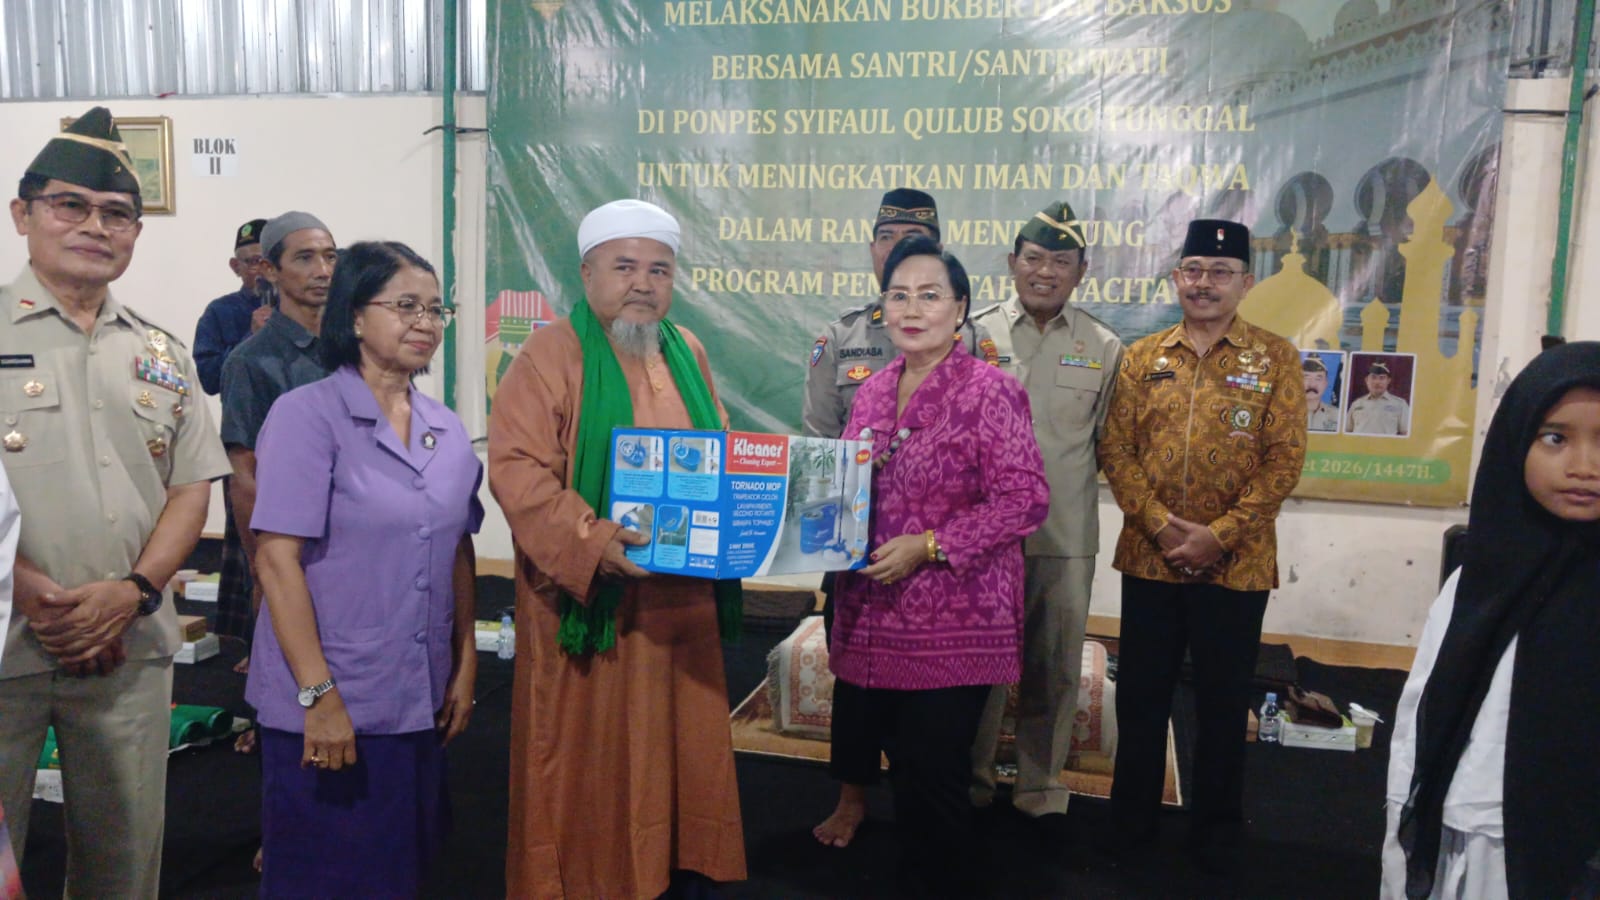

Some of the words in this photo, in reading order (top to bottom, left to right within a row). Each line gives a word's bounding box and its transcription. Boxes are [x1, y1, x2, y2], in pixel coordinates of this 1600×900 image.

[665, 0, 891, 26] MELAKSANAKAN
[712, 53, 842, 80] BERSAMA
[850, 47, 1168, 83] SANTRI/SANTRIWATI
[637, 109, 665, 135] DI
[673, 109, 777, 135] PONPES
[783, 107, 895, 134] SYIFAUL
[904, 105, 1004, 140] QULUB
[1011, 104, 1092, 133] SOKO
[1103, 103, 1256, 132] TUNGGAL
[193, 137, 236, 155] BLOK
[209, 156, 221, 175] II
[637, 163, 729, 189] UNTUK
[738, 162, 965, 190] MENINGKATKAN
[973, 162, 1053, 190] IMAN
[1062, 163, 1131, 190] DAN
[1140, 163, 1250, 192] TAQWA
[718, 217, 813, 243] DALAM
[691, 269, 823, 296] PROGRAM
[733, 438, 784, 458] Kleaner
[1320, 458, 1435, 479] 2026/1447H.
[731, 481, 765, 491] TORNADO
